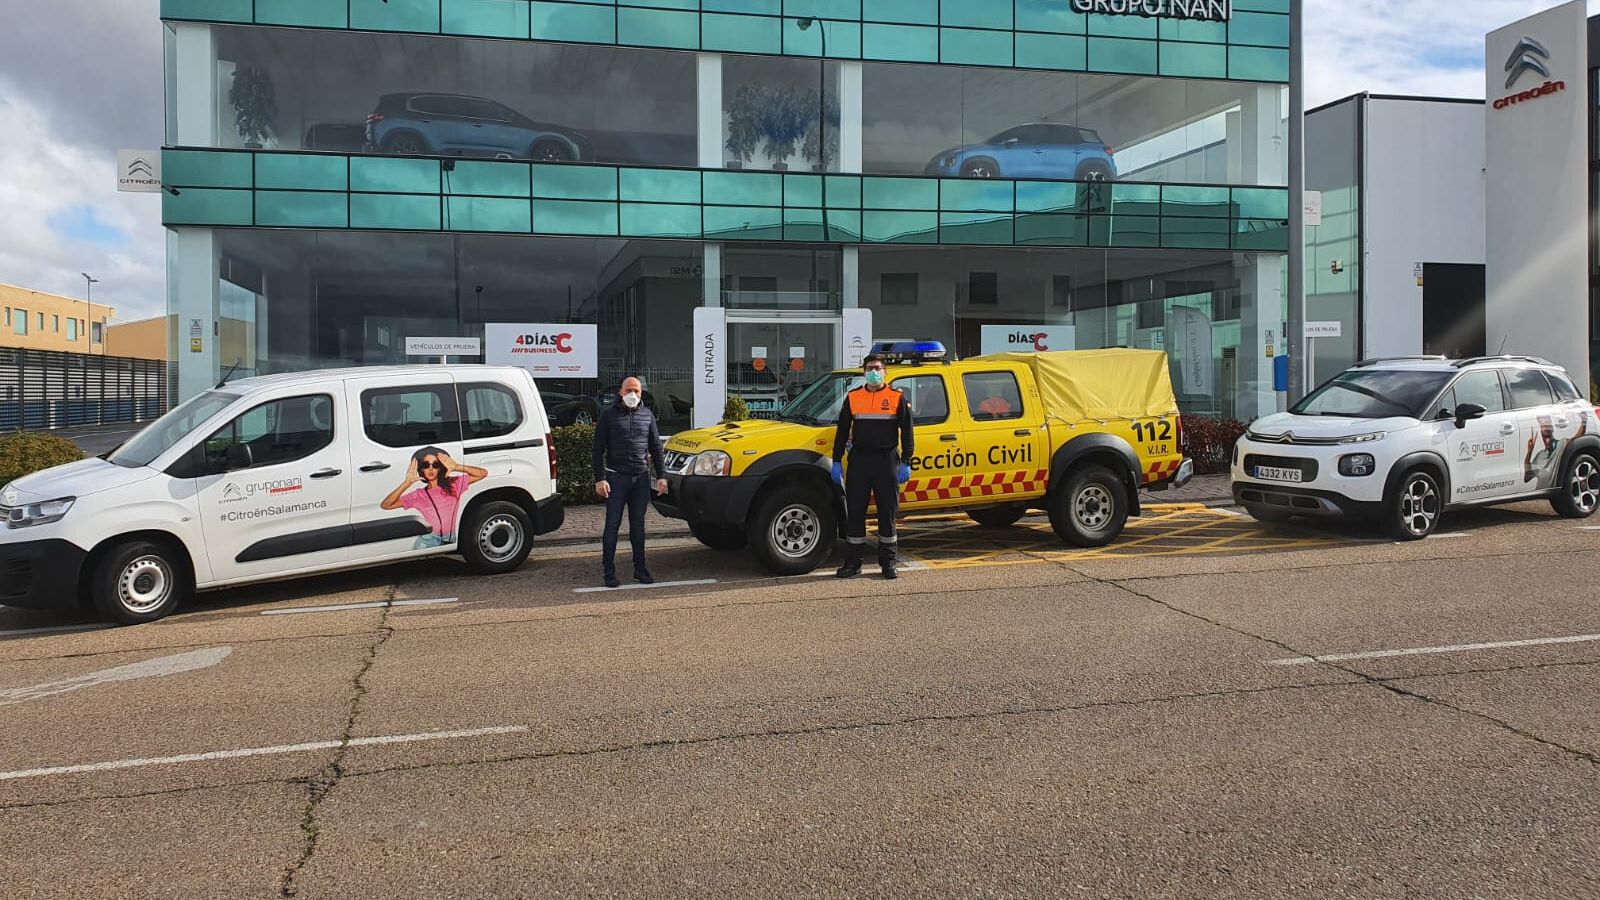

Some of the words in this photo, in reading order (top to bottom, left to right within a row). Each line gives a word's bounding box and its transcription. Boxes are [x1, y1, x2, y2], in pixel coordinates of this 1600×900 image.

[1074, 0, 1162, 15] GRUPO
[1170, 0, 1233, 20] NANI
[704, 332, 715, 385] ENTRADA
[1131, 420, 1172, 443] 112
[910, 448, 977, 472] ección
[987, 443, 1032, 466] Civil
[1147, 444, 1169, 455] V.I.R.
[1260, 468, 1280, 479] 4332
[1282, 469, 1300, 481] KVS
[245, 476, 303, 497] gruponani
[220, 499, 327, 522] #CitroënSalamanca
